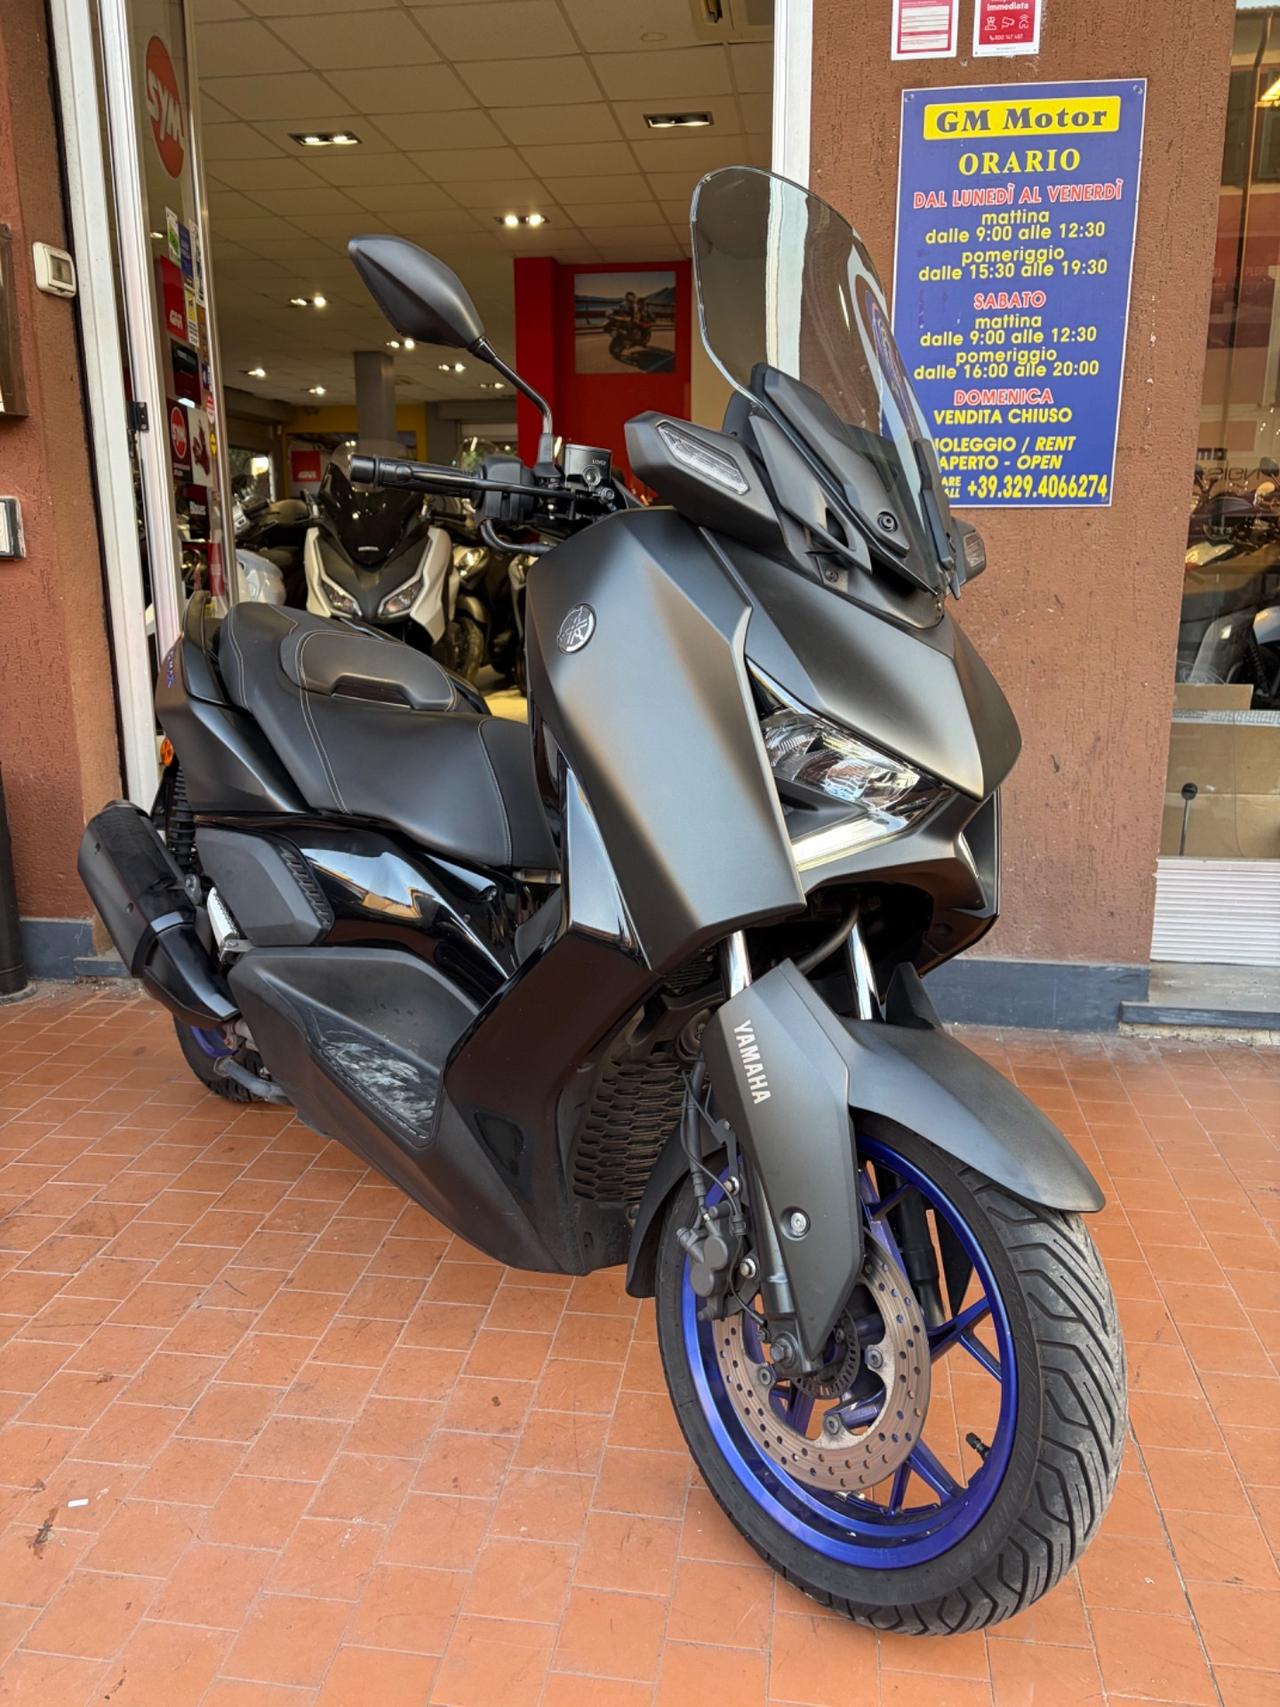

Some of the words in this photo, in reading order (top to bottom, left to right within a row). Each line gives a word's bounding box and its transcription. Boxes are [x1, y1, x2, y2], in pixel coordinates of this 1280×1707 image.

[936, 108, 991, 133] GM
[1002, 106, 1107, 130] Motor
[958, 148, 1081, 176] ORARIO
[913, 191, 947, 209] DAL
[952, 183, 1015, 207] LUNEDÌ
[1018, 186, 1041, 205] AL
[1047, 178, 1124, 203] VENERDÌ
[981, 209, 1050, 226] mattina
[925, 228, 969, 244] dalle
[976, 226, 1012, 241] 9:00
[1018, 224, 1051, 240] alle
[1059, 221, 1106, 239] 12:30
[961, 245, 1065, 266] pomeriggio
[918, 265, 963, 282] dalle
[969, 262, 1015, 279] 15:30
[1020, 260, 1054, 277] alle
[1062, 258, 1108, 276] 19:30
[974, 290, 1047, 310] SABATO
[975, 313, 1042, 330] mattina
[920, 332, 963, 347] dalle
[969, 329, 1006, 345] 9:00
[1011, 328, 1044, 344] alle
[1051, 326, 1098, 343] 12:30
[956, 346, 1057, 367] pomeriggio
[913, 364, 957, 380] dalle
[964, 363, 1009, 378] 16:00
[1013, 361, 1047, 377] alle
[1052, 360, 1100, 376] 20:00
[954, 388, 1054, 406] DOMENICA
[934, 409, 1003, 425] VENDITA
[1008, 407, 1073, 424] CHIUSO
[1021, 437, 1031, 454] /
[1035, 436, 1076, 452] RENT
[939, 456, 999, 471] APERTO
[1017, 455, 1063, 470] OPEN
[967, 474, 1108, 500] +39.329.4066274
[734, 1019, 771, 1104] YAMAHA
